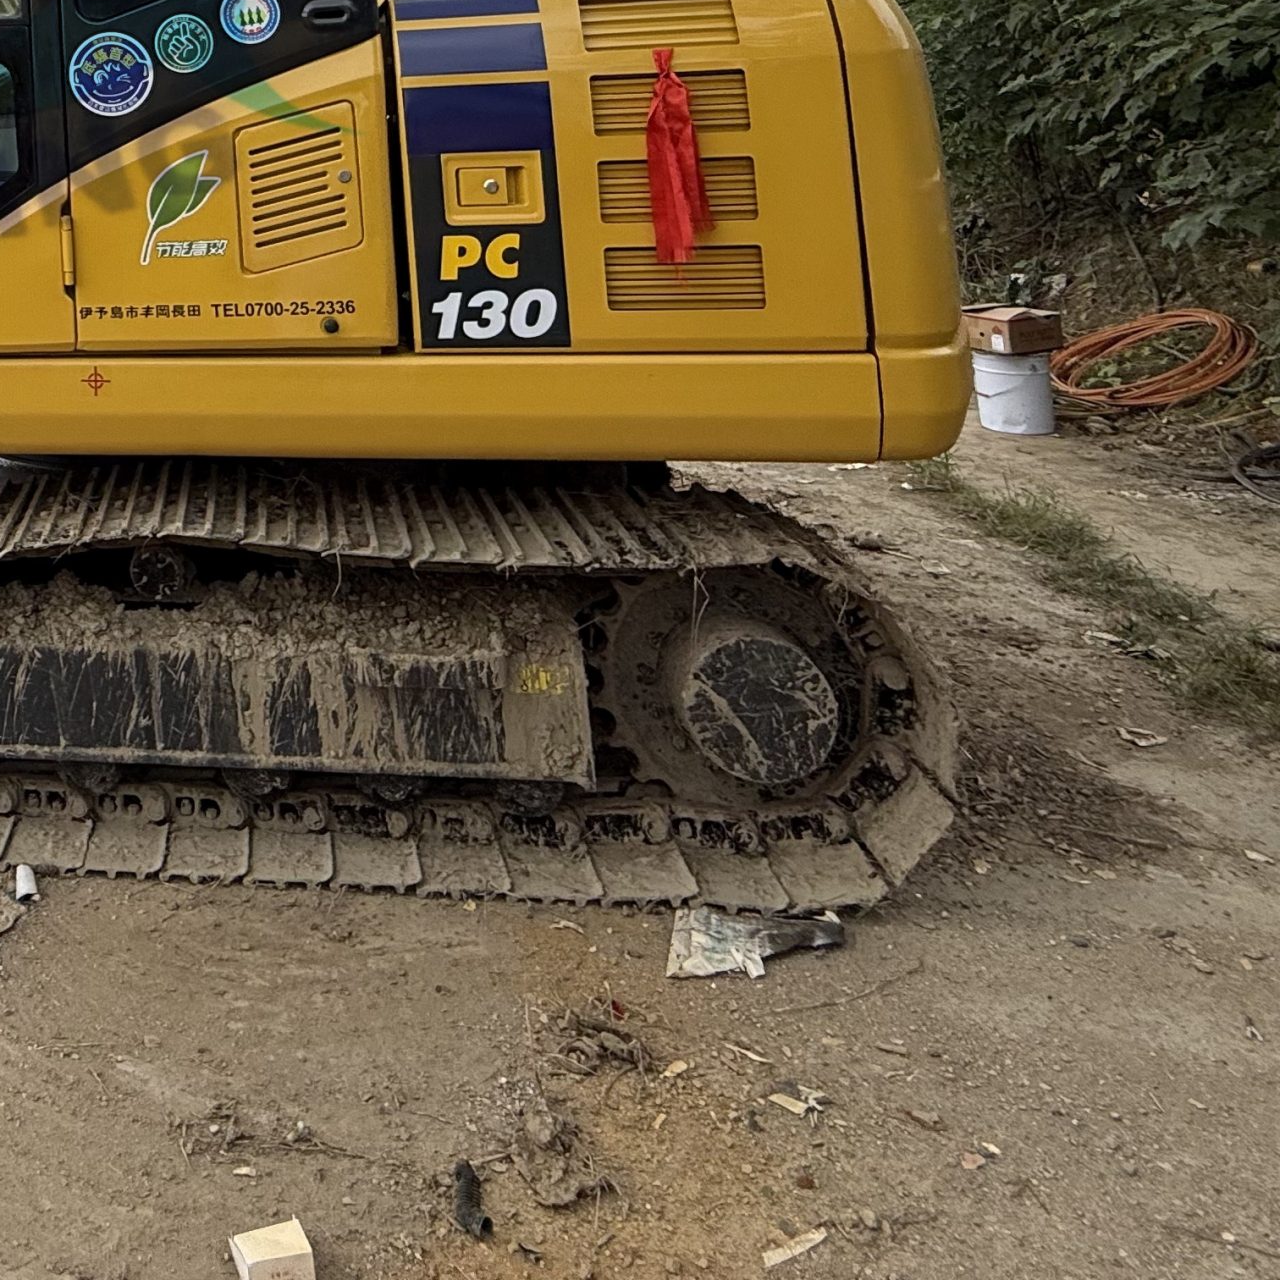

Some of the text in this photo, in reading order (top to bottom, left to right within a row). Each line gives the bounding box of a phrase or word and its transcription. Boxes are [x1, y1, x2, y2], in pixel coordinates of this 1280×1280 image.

[440, 233, 520, 280] PC
[210, 300, 356, 318] TEL0700-25-2336
[431, 288, 558, 340] 130
